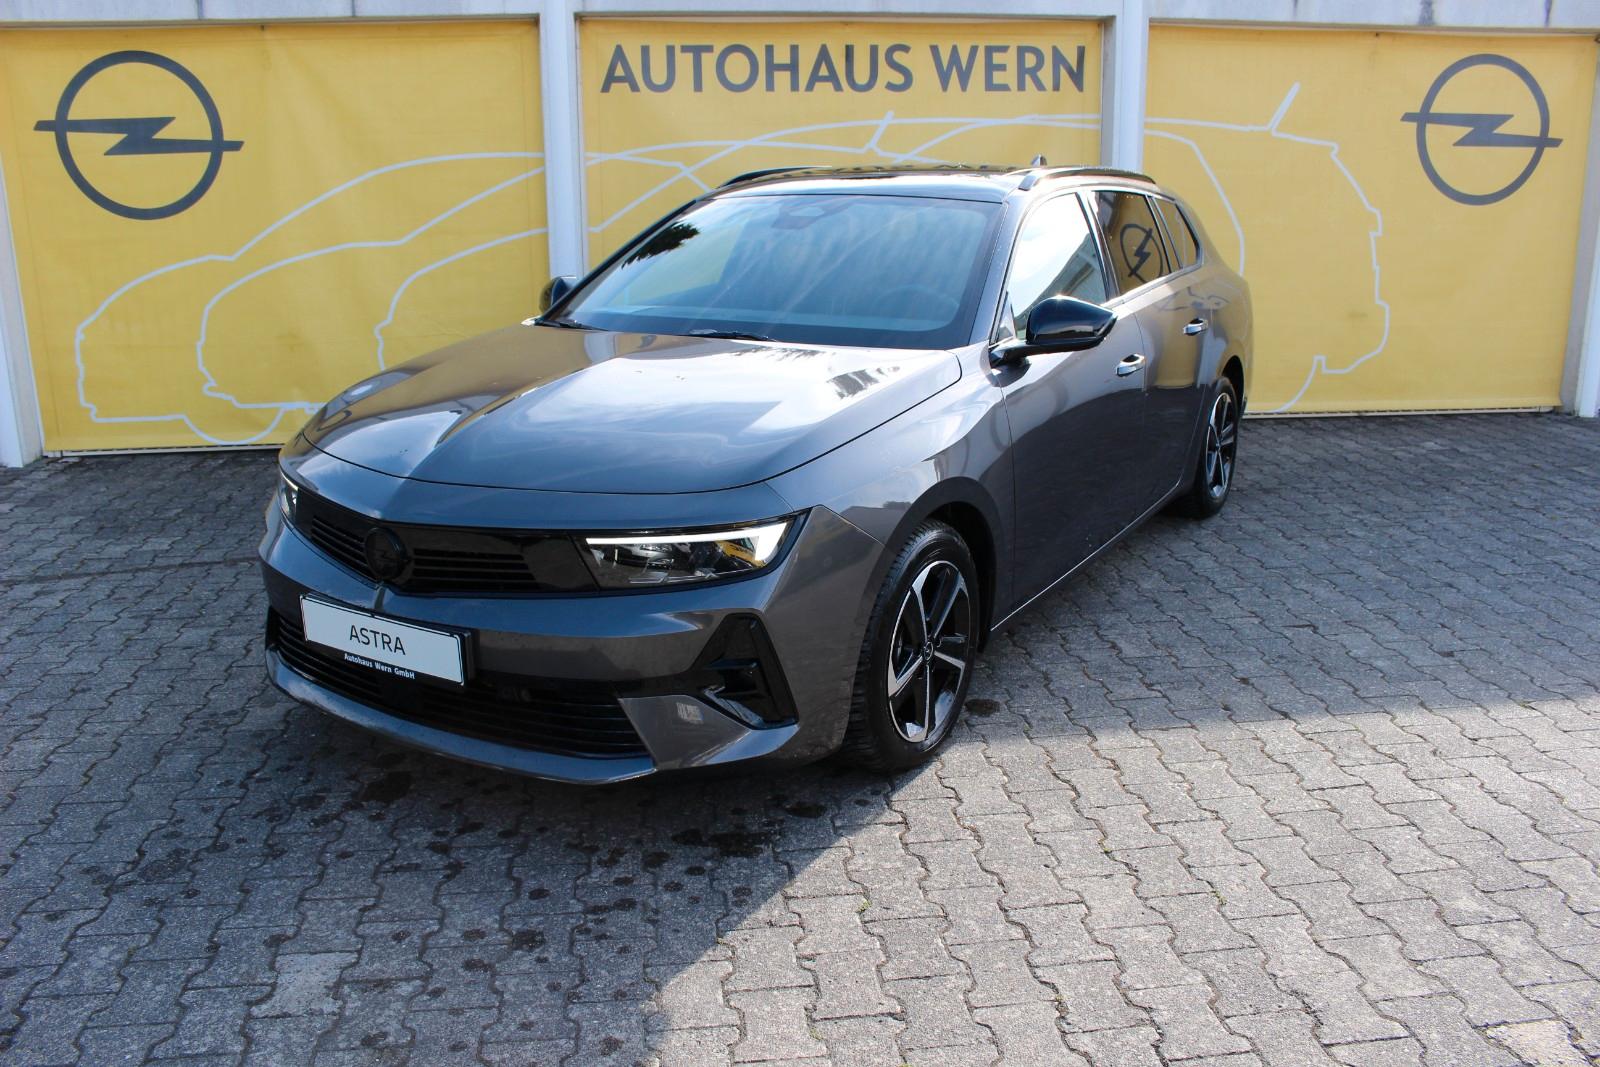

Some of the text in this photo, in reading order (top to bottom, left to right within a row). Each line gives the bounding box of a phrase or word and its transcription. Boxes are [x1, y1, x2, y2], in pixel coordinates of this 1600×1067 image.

[600, 44, 1086, 93] AUTOHAUS WERN
[349, 625, 406, 656] ASTRA
[344, 653, 416, 680] Autohaus Wern GmbH
